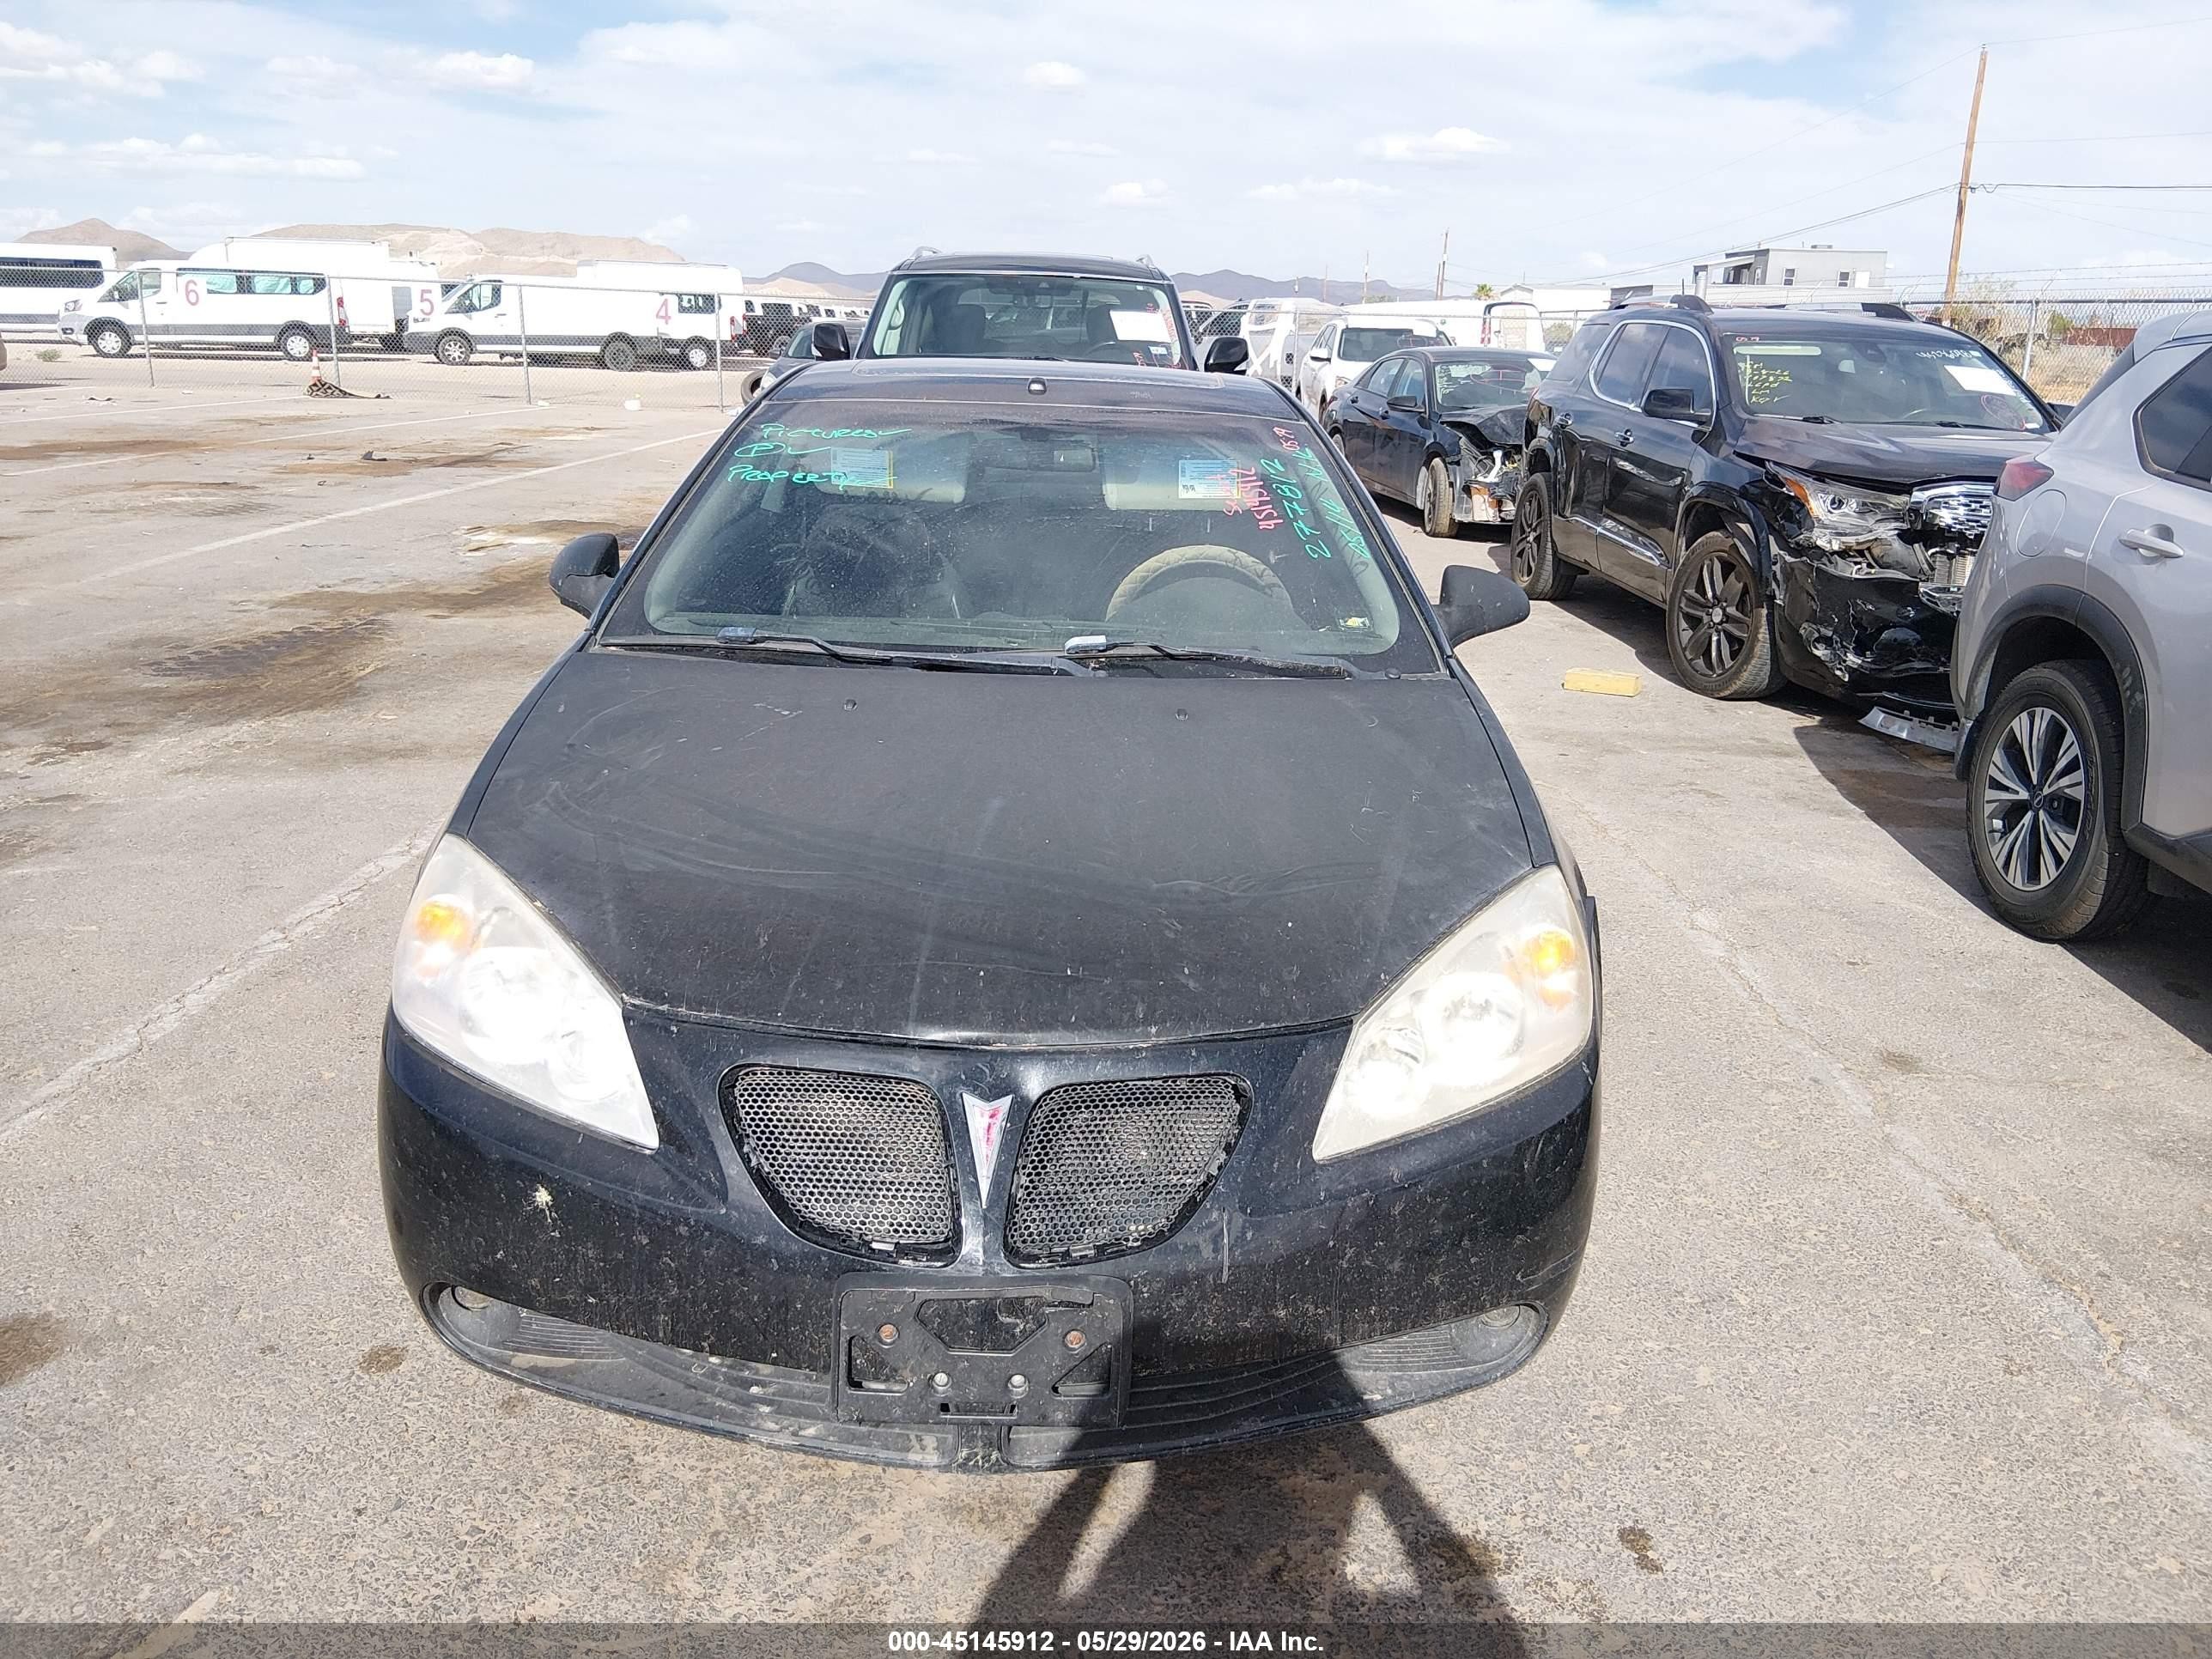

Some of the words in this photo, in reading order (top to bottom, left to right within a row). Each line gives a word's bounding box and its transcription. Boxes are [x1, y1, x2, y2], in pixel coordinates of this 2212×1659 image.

[185, 279, 200, 307] 6
[419, 289, 434, 317] 5
[656, 298, 672, 325] 4
[1228, 466, 1284, 530] 45145912
[1260, 458, 1332, 559] 277812
